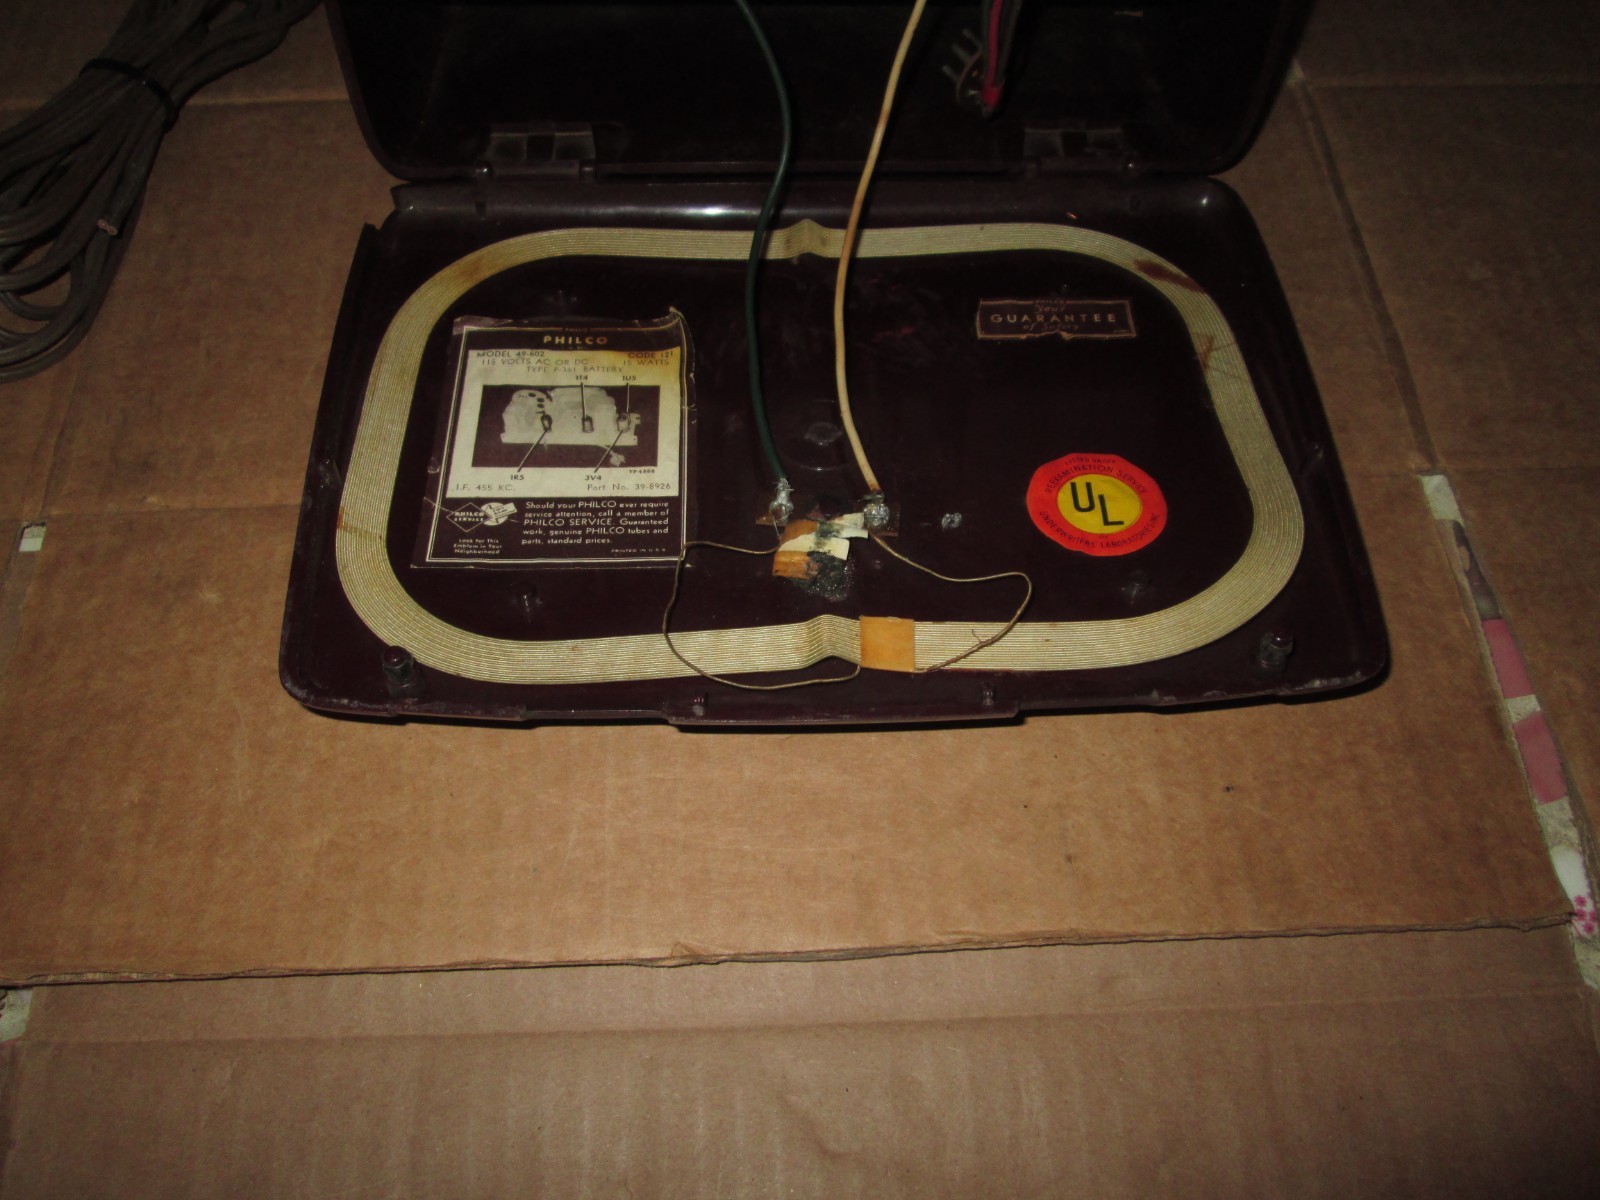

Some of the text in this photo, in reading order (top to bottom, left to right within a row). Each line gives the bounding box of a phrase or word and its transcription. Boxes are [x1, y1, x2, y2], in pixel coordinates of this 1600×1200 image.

[990, 313, 1117, 322] GUARANTEE
[543, 335, 608, 345] PHILCO
[477, 350, 546, 358] MODEL 49-602
[481, 358, 497, 366] 115
[501, 358, 532, 366] VOLTS
[554, 359, 570, 367] OR
[637, 359, 671, 367] WATTS
[612, 483, 629, 491] No.
[635, 482, 671, 490] 39-8926
[525, 501, 555, 509] Should
[557, 503, 577, 511] your
[578, 500, 617, 509] PHILCO
[556, 510, 596, 518] attention,
[598, 509, 613, 517] call
[624, 509, 659, 517] member
[660, 508, 669, 516] of
[523, 518, 566, 527] PHILCO
[620, 517, 669, 526] Guaranteed
[522, 528, 547, 536] work,
[550, 529, 583, 537] genuine
[585, 526, 625, 535] PHILCO
[653, 526, 669, 534] and
[521, 536, 613, 546] parts, standard prices.
